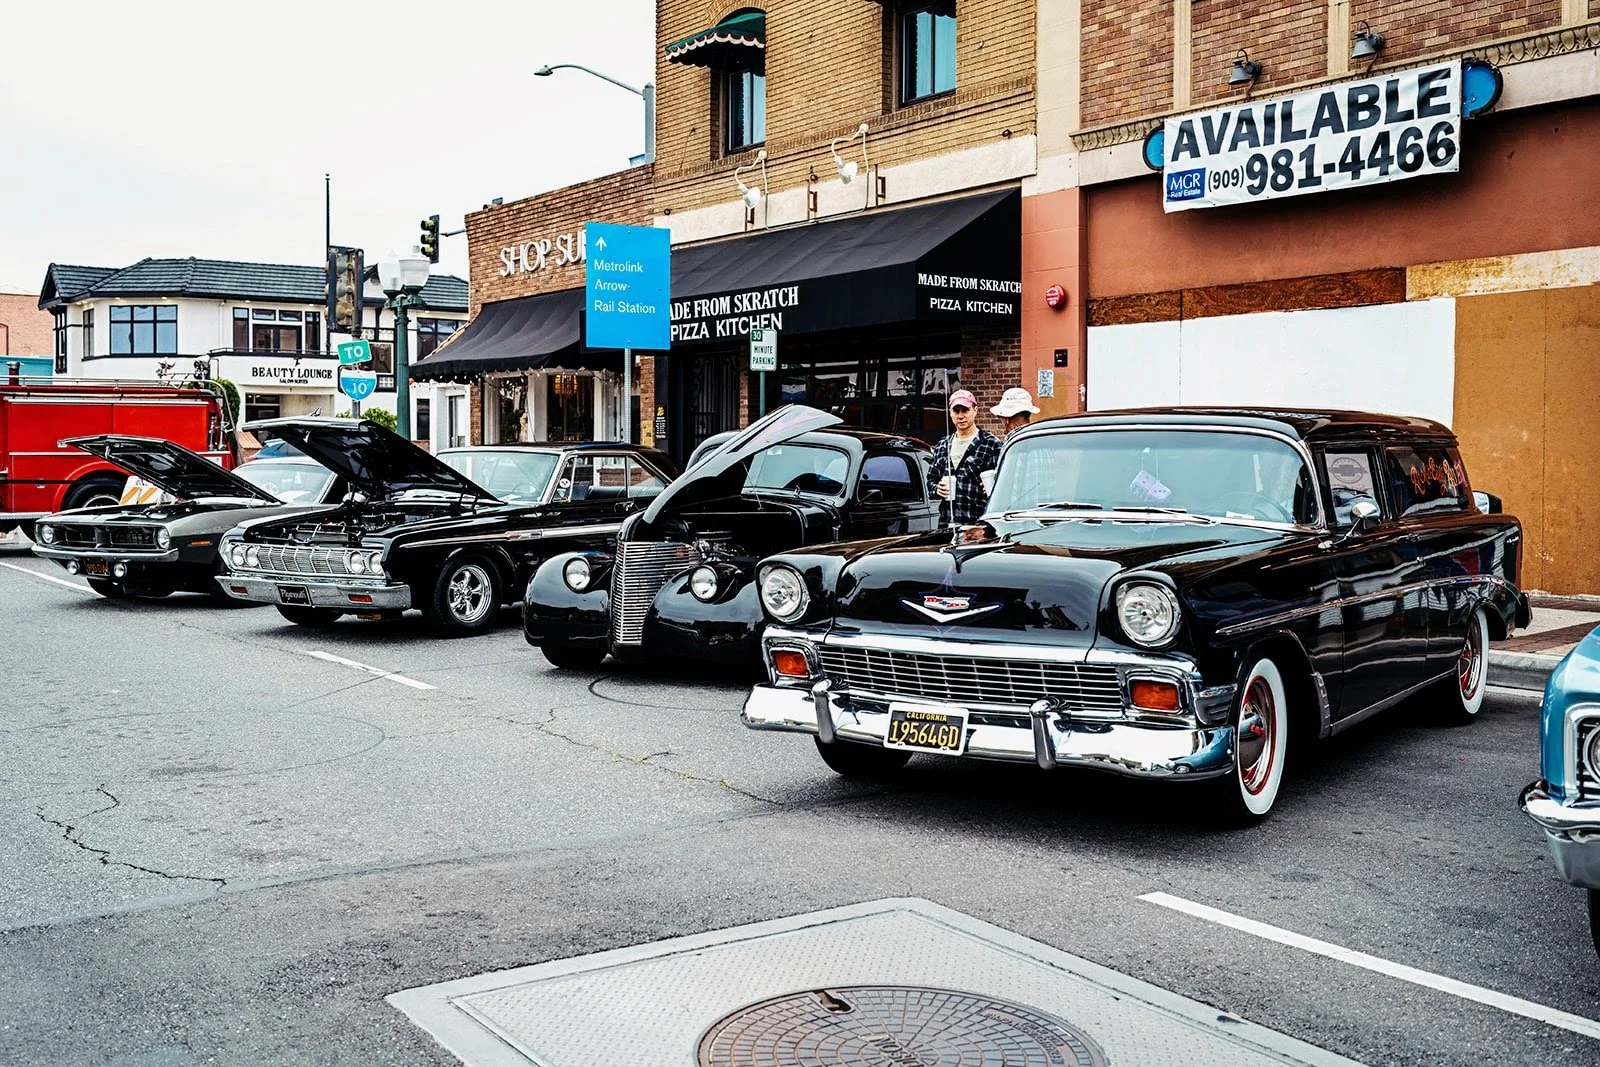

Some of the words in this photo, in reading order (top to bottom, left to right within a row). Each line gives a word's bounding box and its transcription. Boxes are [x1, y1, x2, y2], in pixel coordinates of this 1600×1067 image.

[1171, 67, 1451, 162] AVAILABLE
[1170, 172, 1200, 191] MGR
[1170, 190, 1183, 198] Real
[1184, 188, 1201, 197] Estate
[498, 239, 551, 277] SHOP
[594, 259, 643, 273] Metrolink
[918, 273, 948, 287] MADE
[950, 277, 978, 289] FROM
[980, 280, 1022, 293] SKRATCH
[594, 301, 614, 312] Rail
[617, 303, 655, 314] Station
[694, 296, 731, 319] FROM
[734, 286, 799, 313] SKRATCH
[930, 298, 961, 311] PIZZA
[967, 300, 1012, 314] KITCHEN
[670, 322, 709, 341] PIZZA
[716, 312, 782, 337] KITCHEN
[752, 331, 762, 340] 30
[344, 346, 363, 359] TO
[754, 346, 773, 354] MINUTE
[753, 357, 774, 365] PARKING
[252, 367, 295, 378] BEAUTY
[297, 369, 333, 379] LOUNGE
[353, 382, 367, 394] 10
[906, 712, 947, 722] CALIFORNIA
[889, 720, 959, 747] 19564GD
